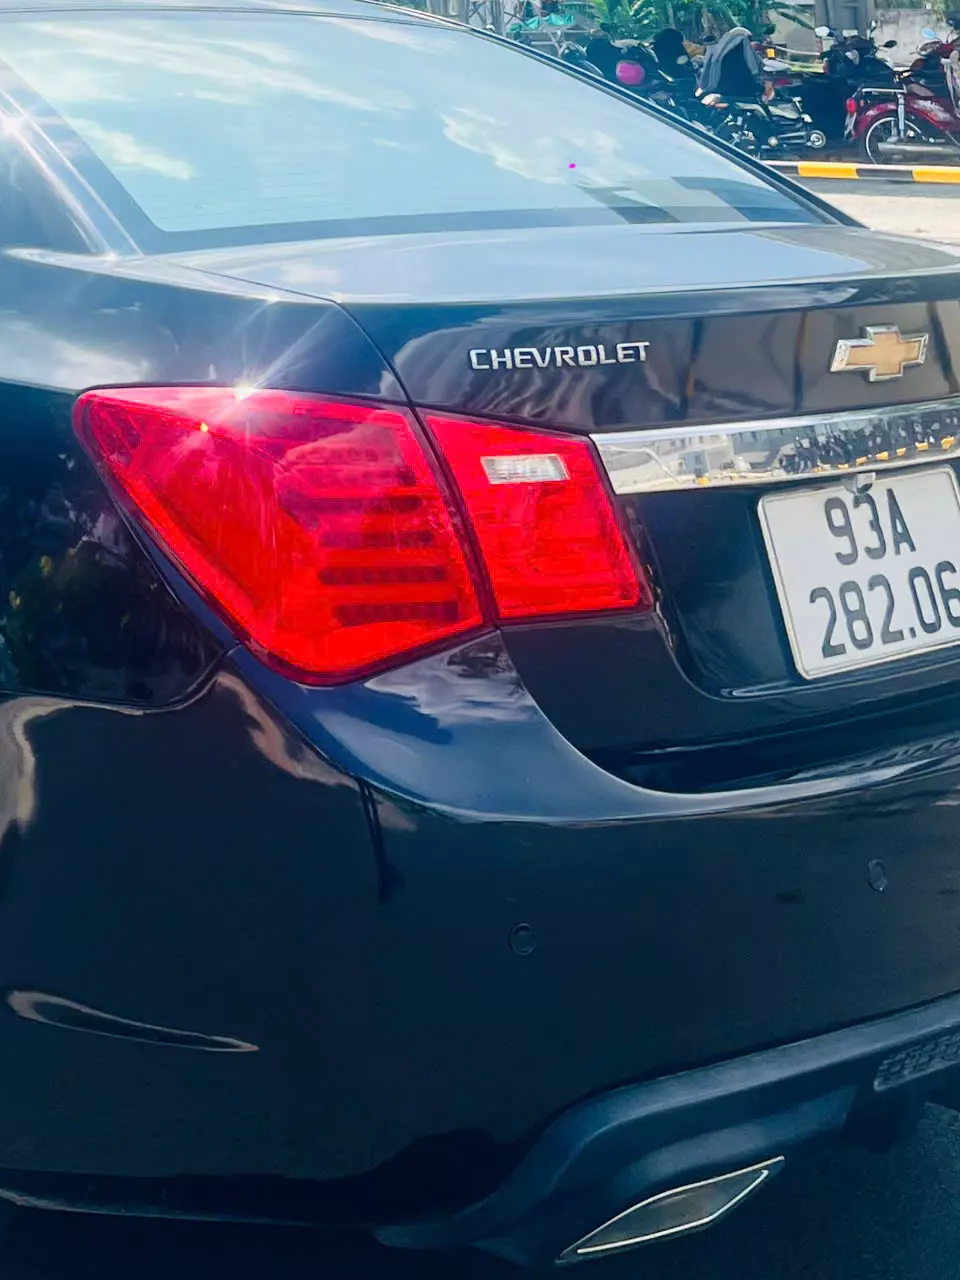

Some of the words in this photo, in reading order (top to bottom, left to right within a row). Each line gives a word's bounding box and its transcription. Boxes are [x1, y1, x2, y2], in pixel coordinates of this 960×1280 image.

[469, 341, 651, 370] CHEVROLET
[824, 488, 916, 565] 93A
[809, 560, 960, 658] 282.06
